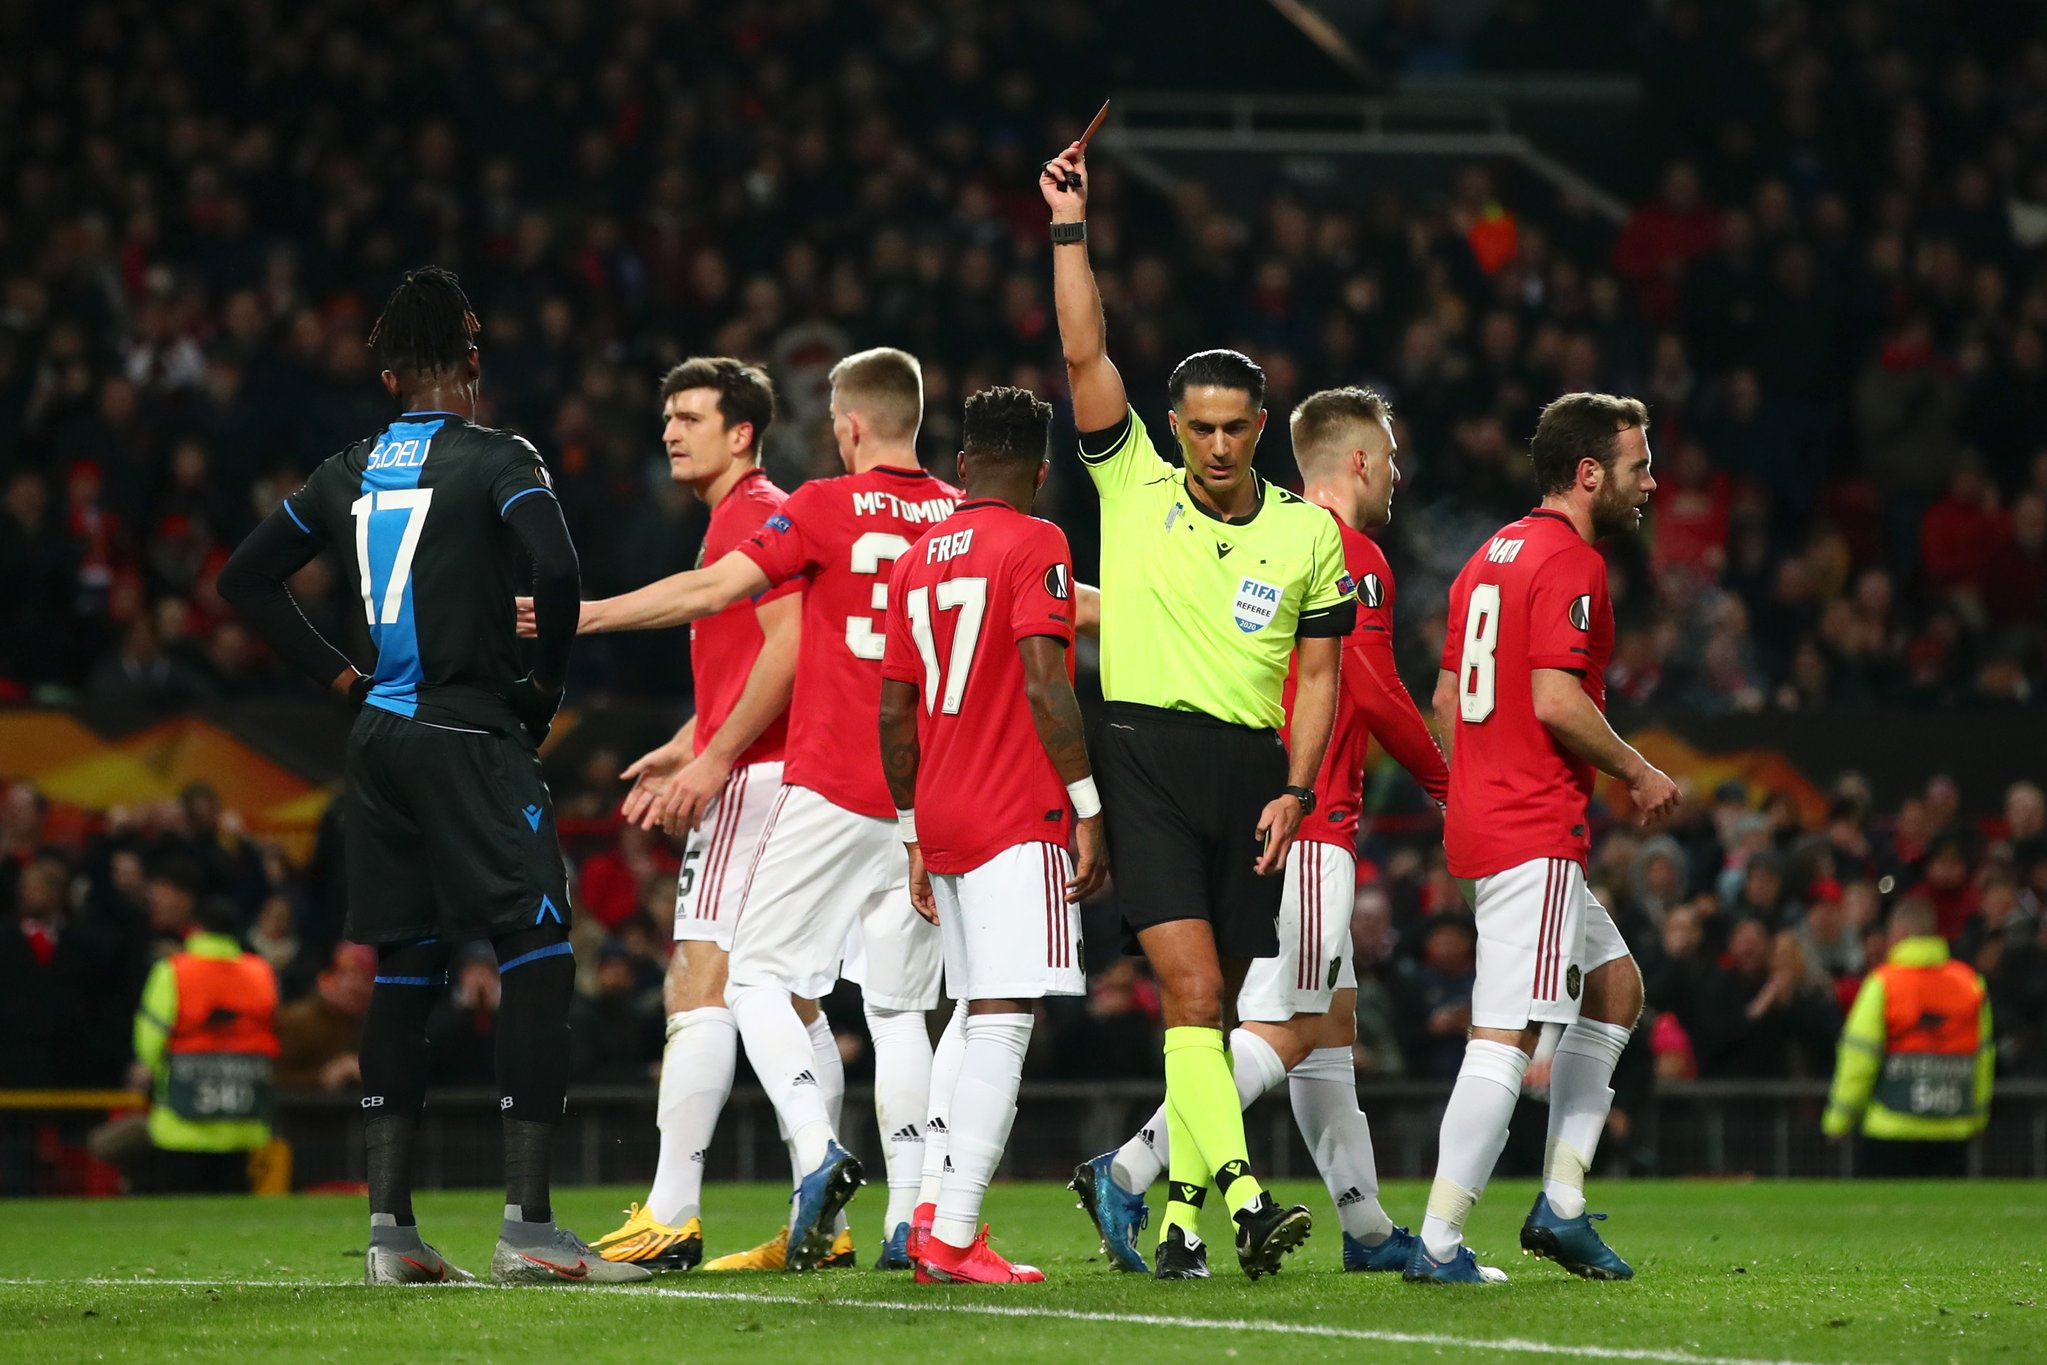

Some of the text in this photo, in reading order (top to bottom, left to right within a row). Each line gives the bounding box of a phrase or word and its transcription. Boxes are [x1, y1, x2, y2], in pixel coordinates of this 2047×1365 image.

[366, 438, 432, 471] S.DELI
[851, 490, 966, 524] McTOMIN
[350, 487, 434, 626] 17
[926, 528, 974, 565] FRED
[1484, 536, 1525, 564] MATA
[845, 531, 913, 661] 3
[1236, 600, 1272, 617] REFEREE
[1241, 580, 1276, 602] FIFA
[1240, 620, 1257, 631] 2020
[907, 577, 988, 717] 17
[1459, 583, 1501, 723] 8
[679, 850, 701, 897] 5
